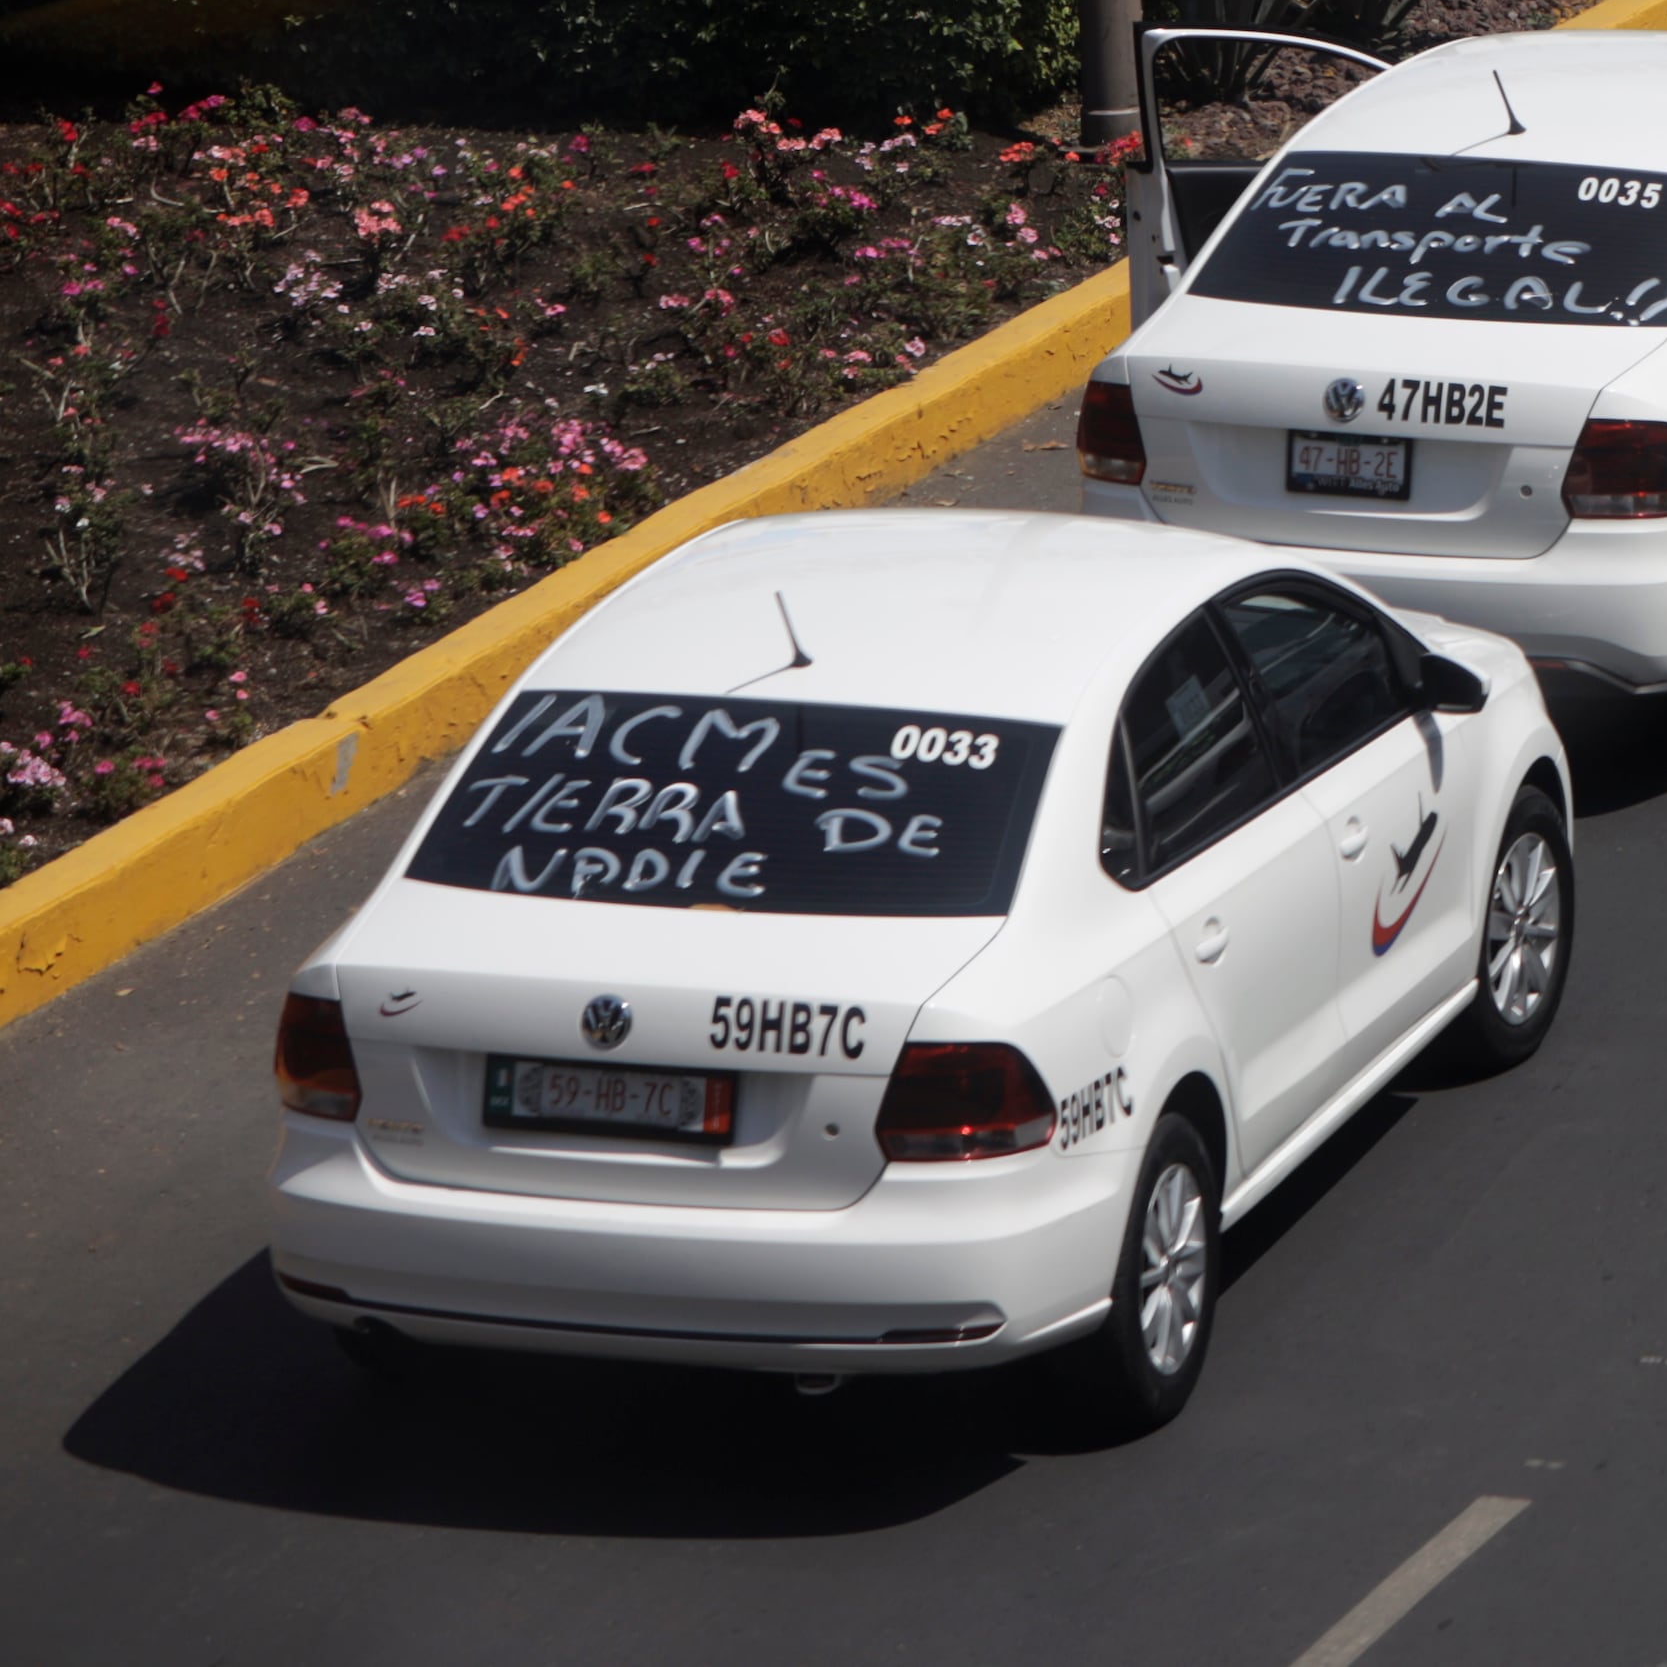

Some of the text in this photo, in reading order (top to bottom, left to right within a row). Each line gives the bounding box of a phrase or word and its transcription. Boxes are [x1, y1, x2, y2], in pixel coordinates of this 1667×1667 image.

[1250, 167, 1507, 223] FUERA AL
[1577, 177, 1663, 209] 0035
[1278, 218, 1592, 265] Transporte
[1378, 378, 1508, 428] 47HB2E
[1300, 445, 1398, 479] 47-HB-2E
[890, 724, 999, 769] 0033
[782, 749, 909, 801] ES
[463, 774, 943, 859] TIERRA DE
[711, 995, 868, 1061] 59HB7C
[549, 1072, 676, 1117] 59-HB-7C
[1059, 1067, 1133, 1151] 59HB7C
